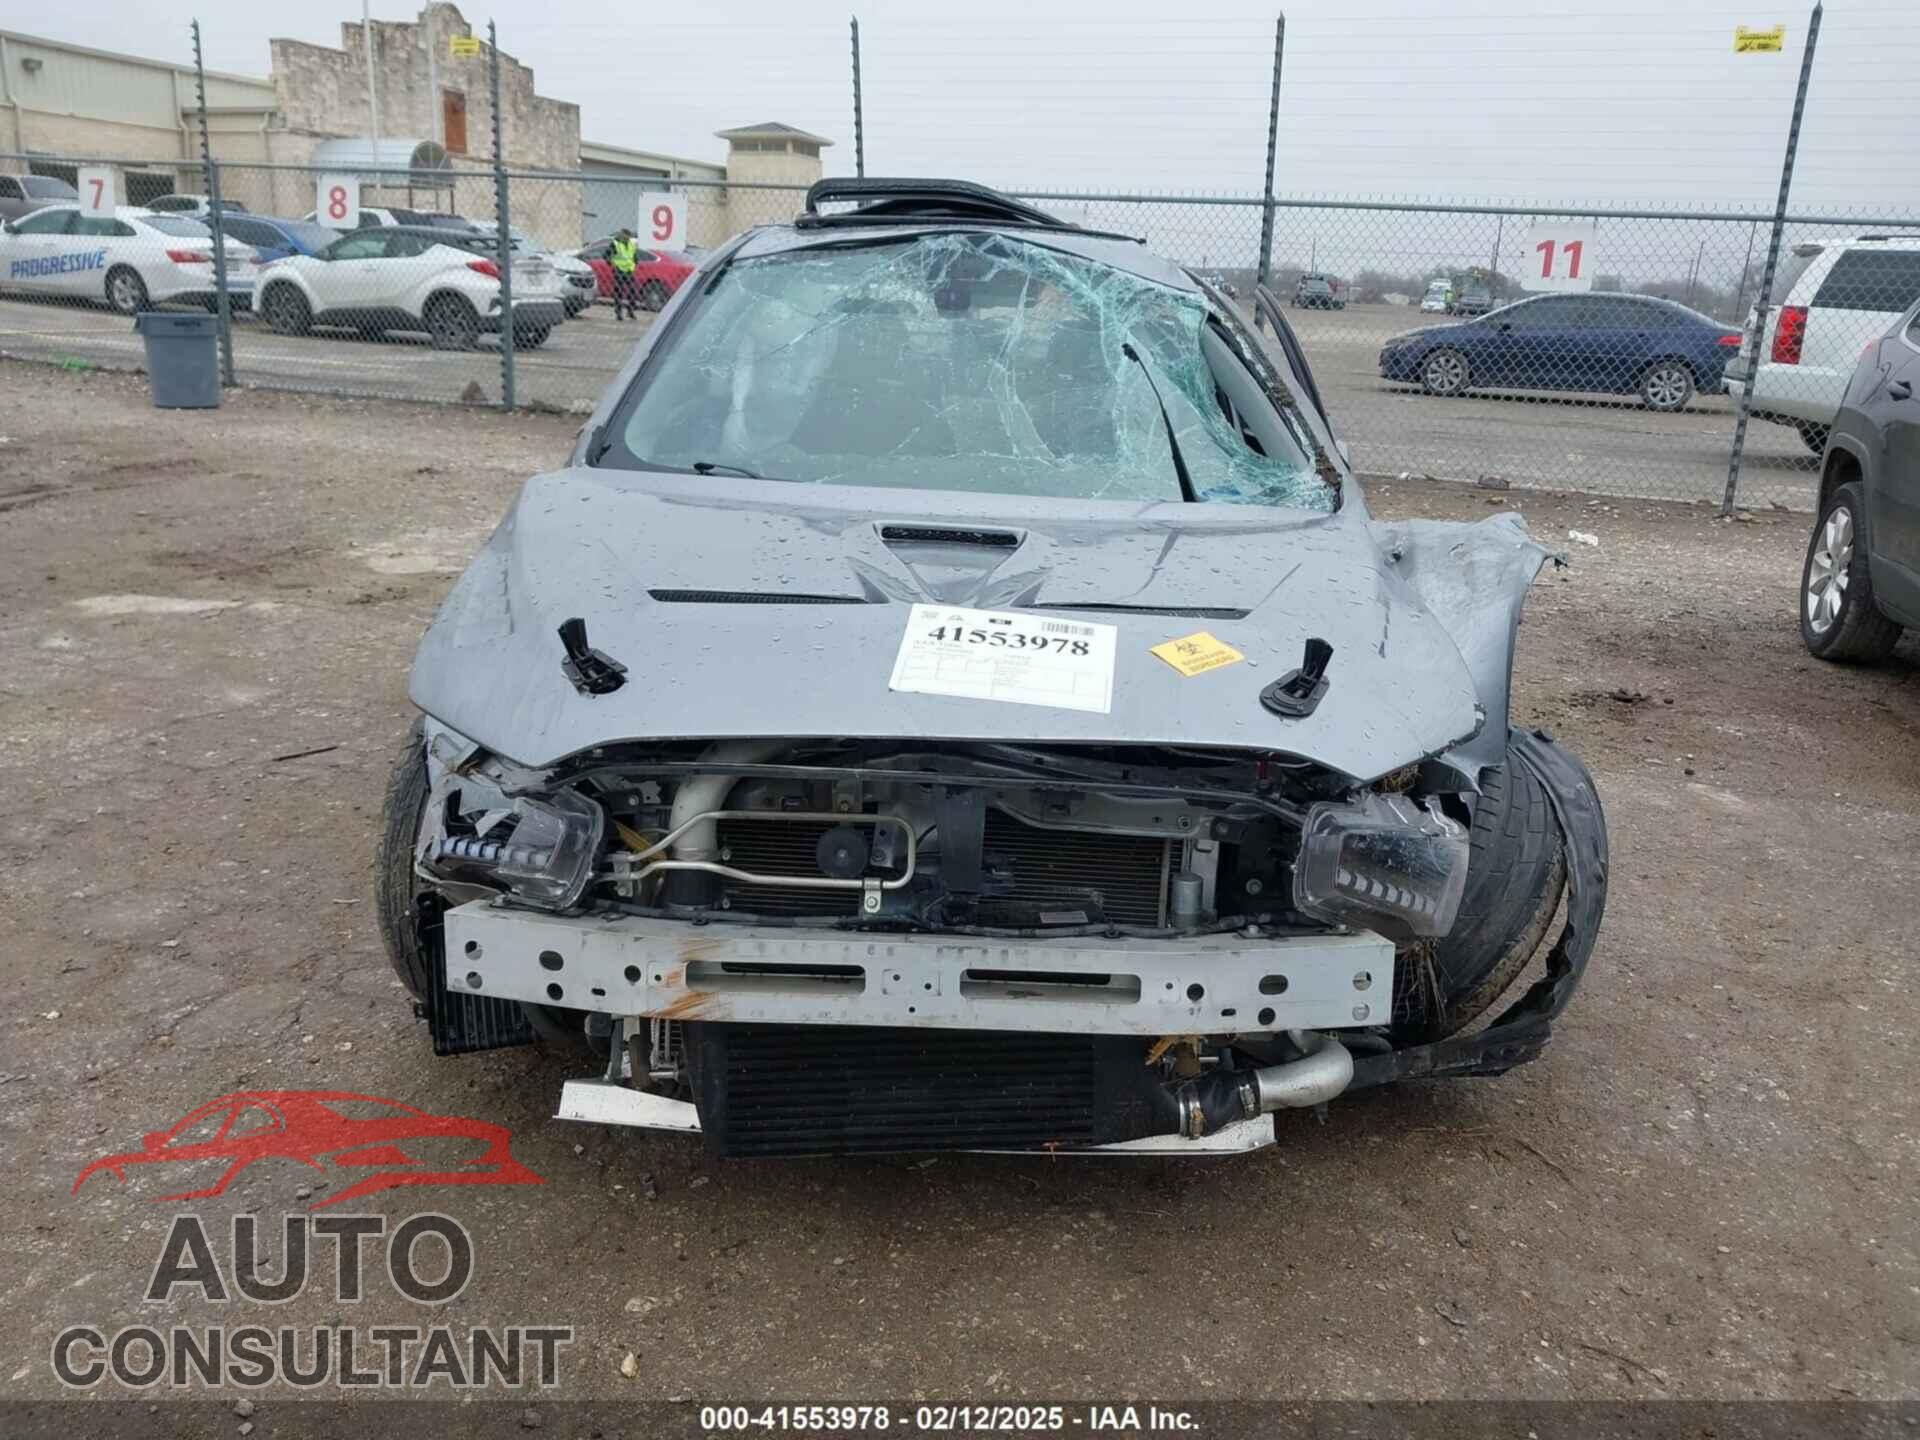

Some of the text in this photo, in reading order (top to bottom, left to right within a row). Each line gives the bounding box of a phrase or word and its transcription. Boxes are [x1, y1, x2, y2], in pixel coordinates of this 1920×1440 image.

[89, 178, 105, 210] 7
[328, 185, 347, 220] 8
[651, 205, 674, 241] 9
[11, 250, 107, 279] PROGRESSIVE
[1536, 240, 1584, 279] 11
[928, 625, 1090, 656] 41553978
